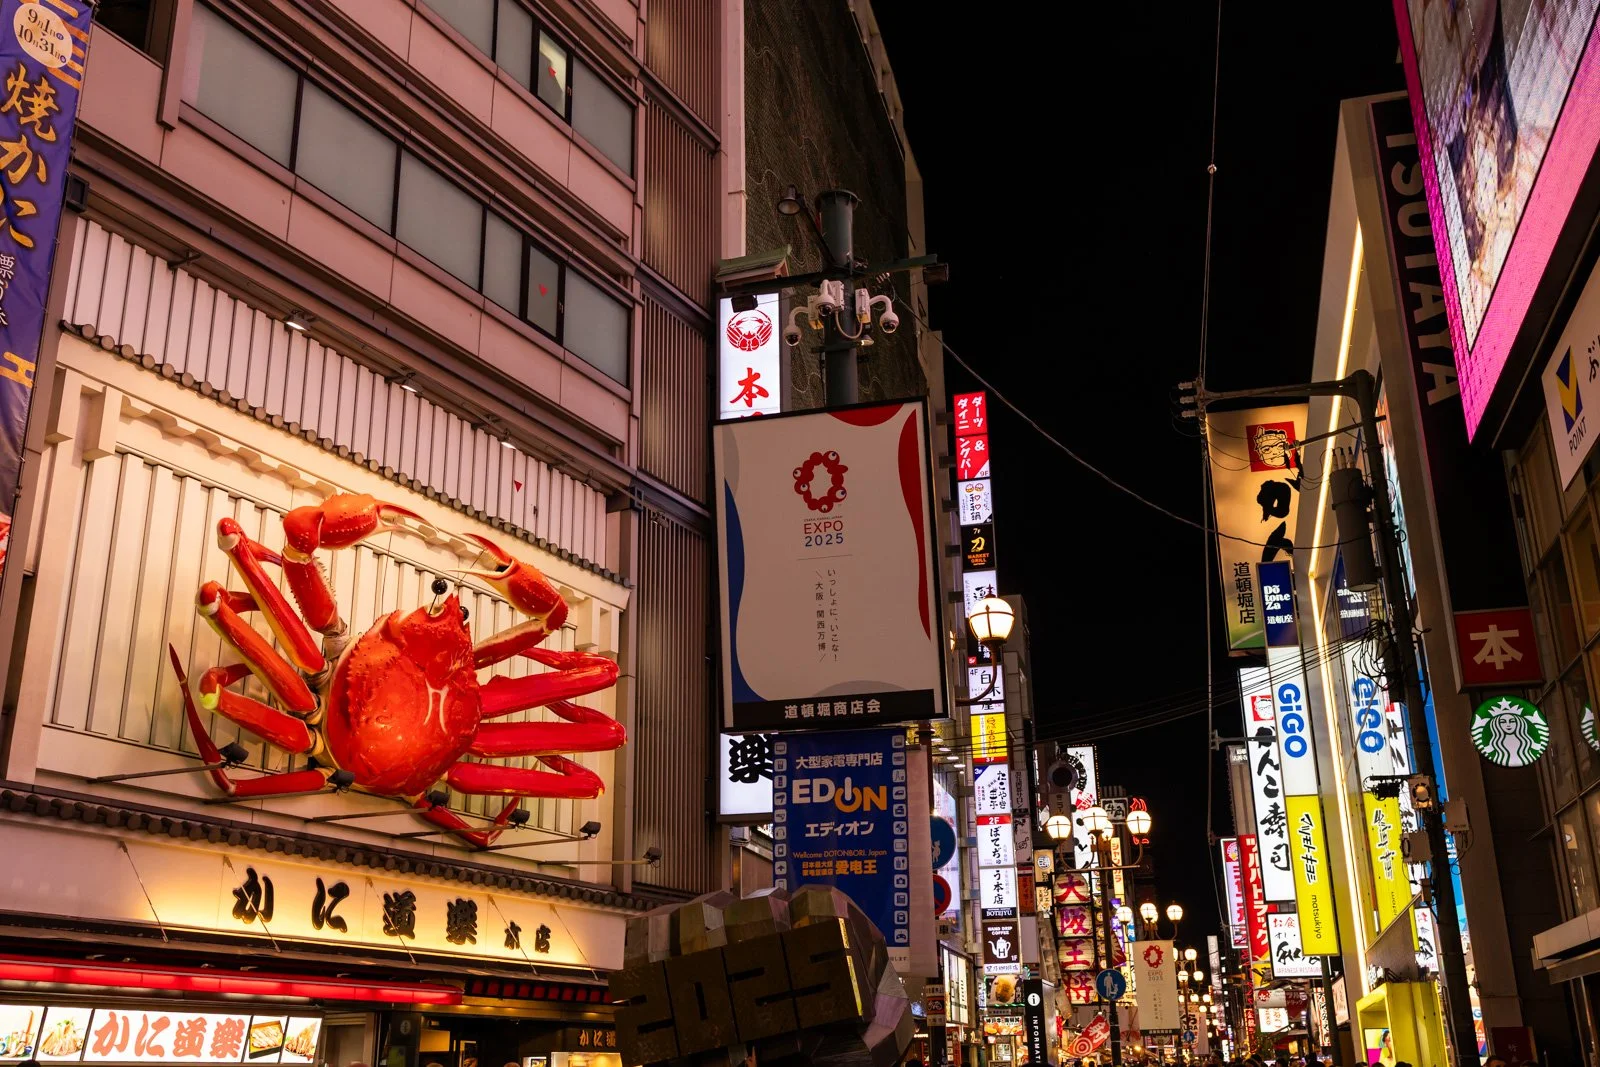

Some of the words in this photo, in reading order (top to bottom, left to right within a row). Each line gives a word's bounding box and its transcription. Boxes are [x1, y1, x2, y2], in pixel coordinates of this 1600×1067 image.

[1568, 416, 1587, 456] POINT
[804, 520, 843, 534] EXPO
[805, 533, 843, 547] 2025
[1233, 561, 1255, 624] 道頓堀店
[1469, 624, 1524, 670] 本
[970, 668, 978, 676] 4F
[783, 698, 882, 719] 道頓堀商店会
[796, 752, 883, 769] 大型家電専門店
[792, 777, 887, 813] EDION
[805, 821, 874, 837] エディオン
[989, 817, 1000, 825] 2F
[1298, 812, 1319, 885] マツモトキヨシ
[1310, 895, 1322, 940] matsukiyo
